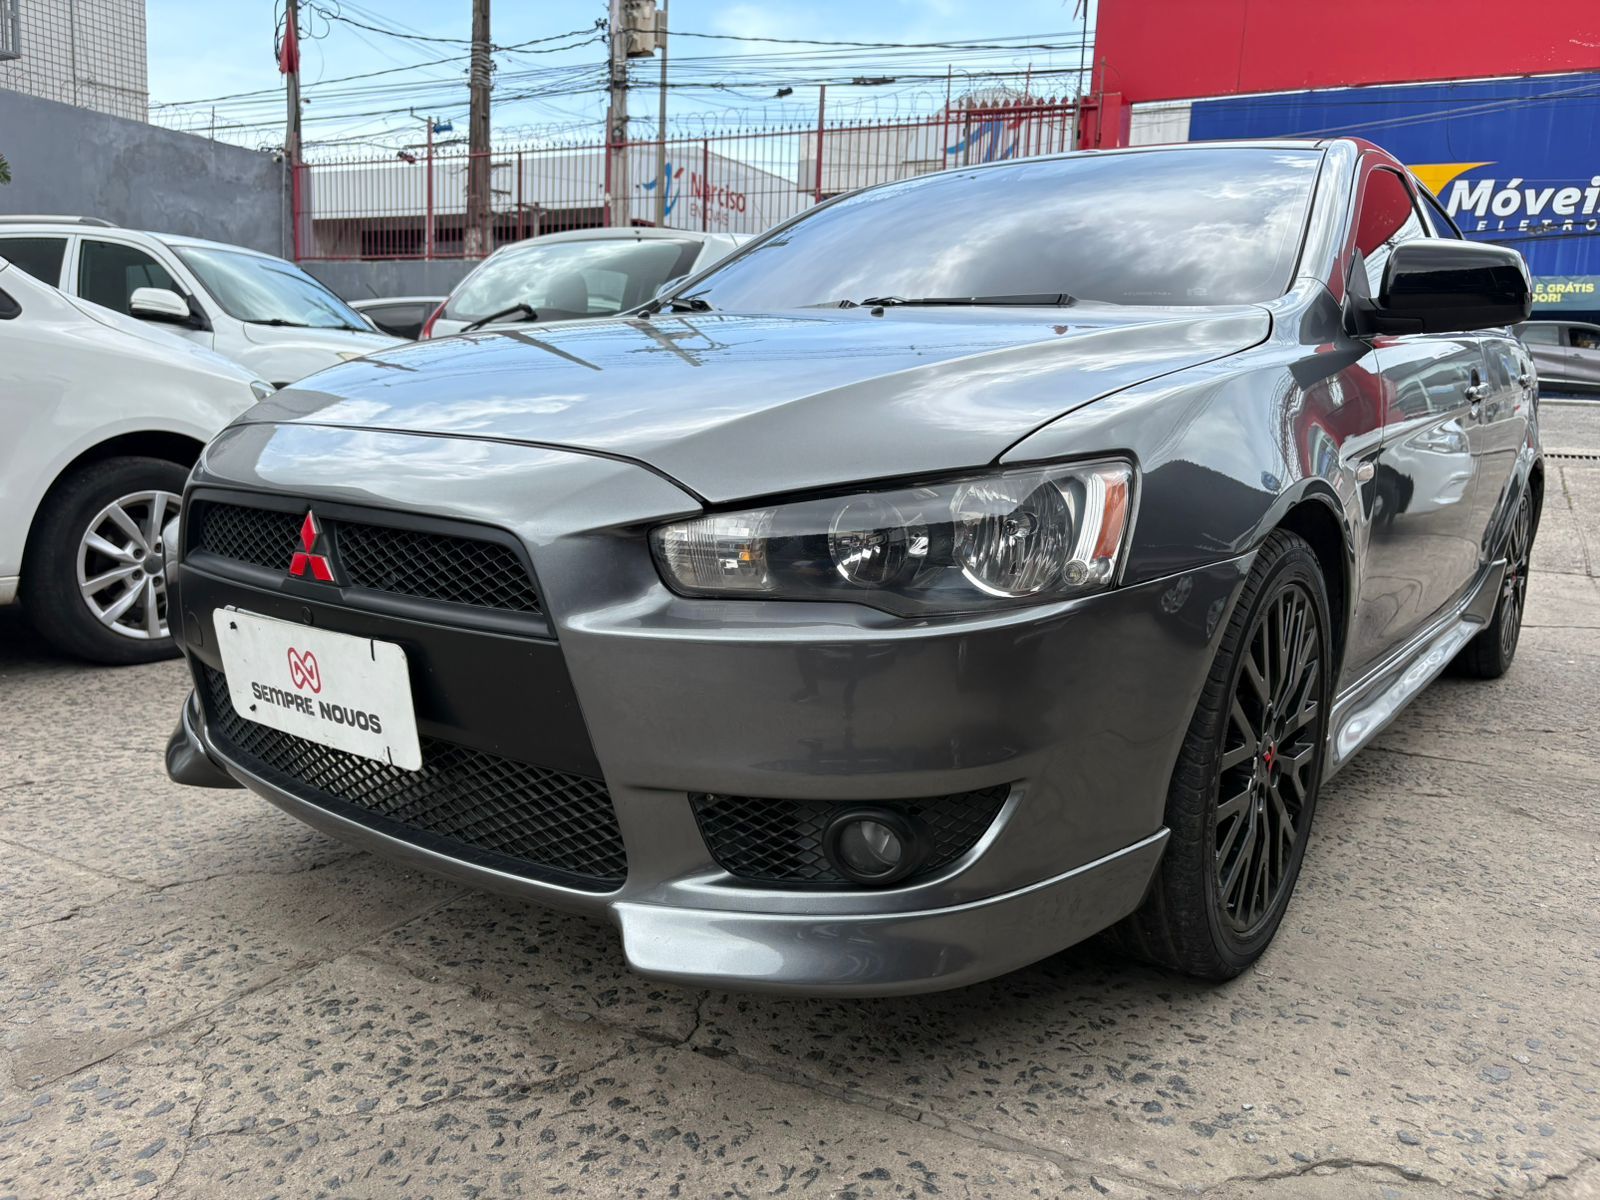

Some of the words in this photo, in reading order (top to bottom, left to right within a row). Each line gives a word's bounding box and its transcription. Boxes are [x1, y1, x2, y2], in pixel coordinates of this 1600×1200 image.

[1446, 175, 1600, 217] Móvei
[1547, 281, 1594, 293] GRÁTIS
[251, 682, 315, 716] SEMPRE
